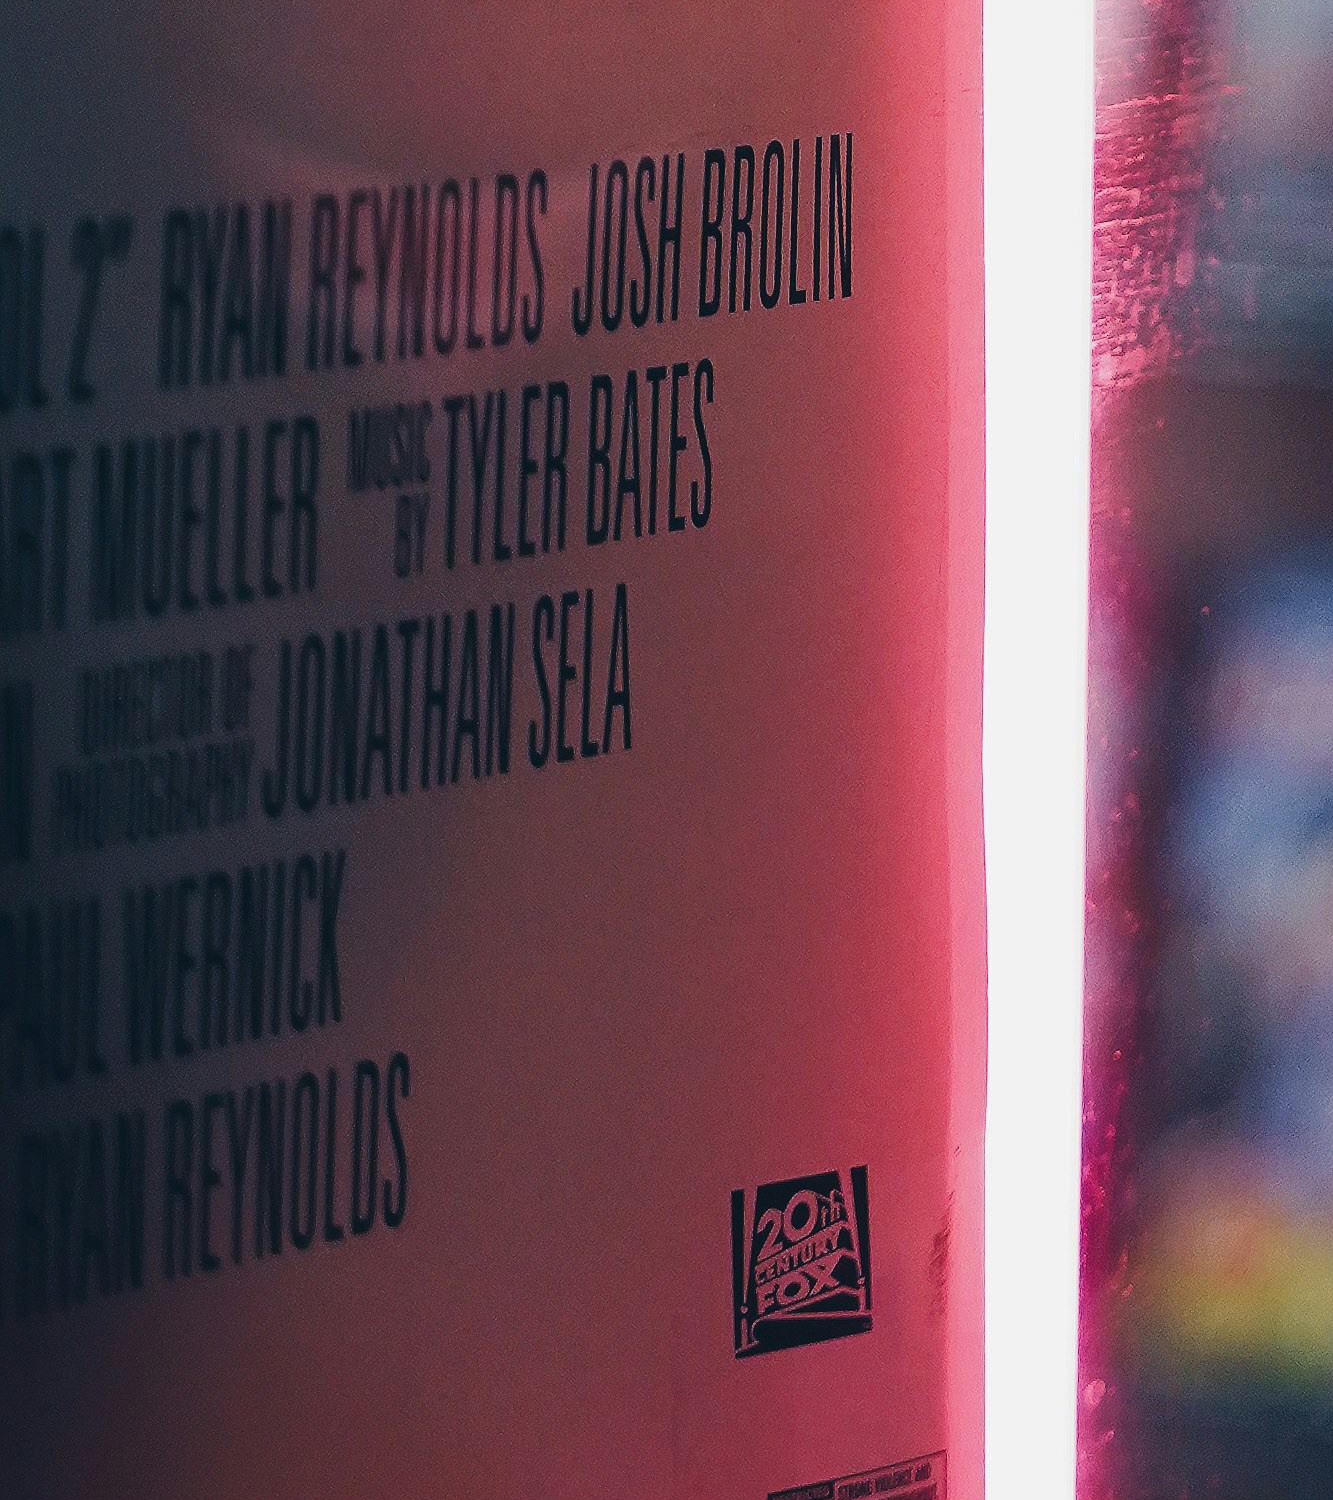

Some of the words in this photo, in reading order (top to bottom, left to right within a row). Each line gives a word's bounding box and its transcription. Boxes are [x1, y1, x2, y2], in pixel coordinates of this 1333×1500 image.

[158, 197, 293, 390] RYAN
[306, 168, 548, 370] REYNOLDS
[572, 152, 685, 336] JOSH
[699, 133, 854, 318] BROLIN
[349, 401, 431, 490] MUSIC
[443, 382, 569, 570] TYLER
[586, 359, 715, 545] BATES
[92, 415, 319, 621] MUELLER
[395, 492, 429, 577] BY
[79, 651, 213, 756] DIRECTOR
[222, 644, 256, 731] OF
[262, 604, 516, 816] JONATHAN
[528, 583, 633, 769] SELA
[52, 738, 255, 856] PHOTOGRAPHY
[126, 851, 345, 1065] WERNICK
[15, 1109, 145, 1316] RYAN
[164, 1052, 411, 1278] REYNOLDS
[755, 1225, 842, 1287] CENTURY
[756, 1255, 842, 1314] FOX
[875, 1467, 913, 1493] VIOLENCE
